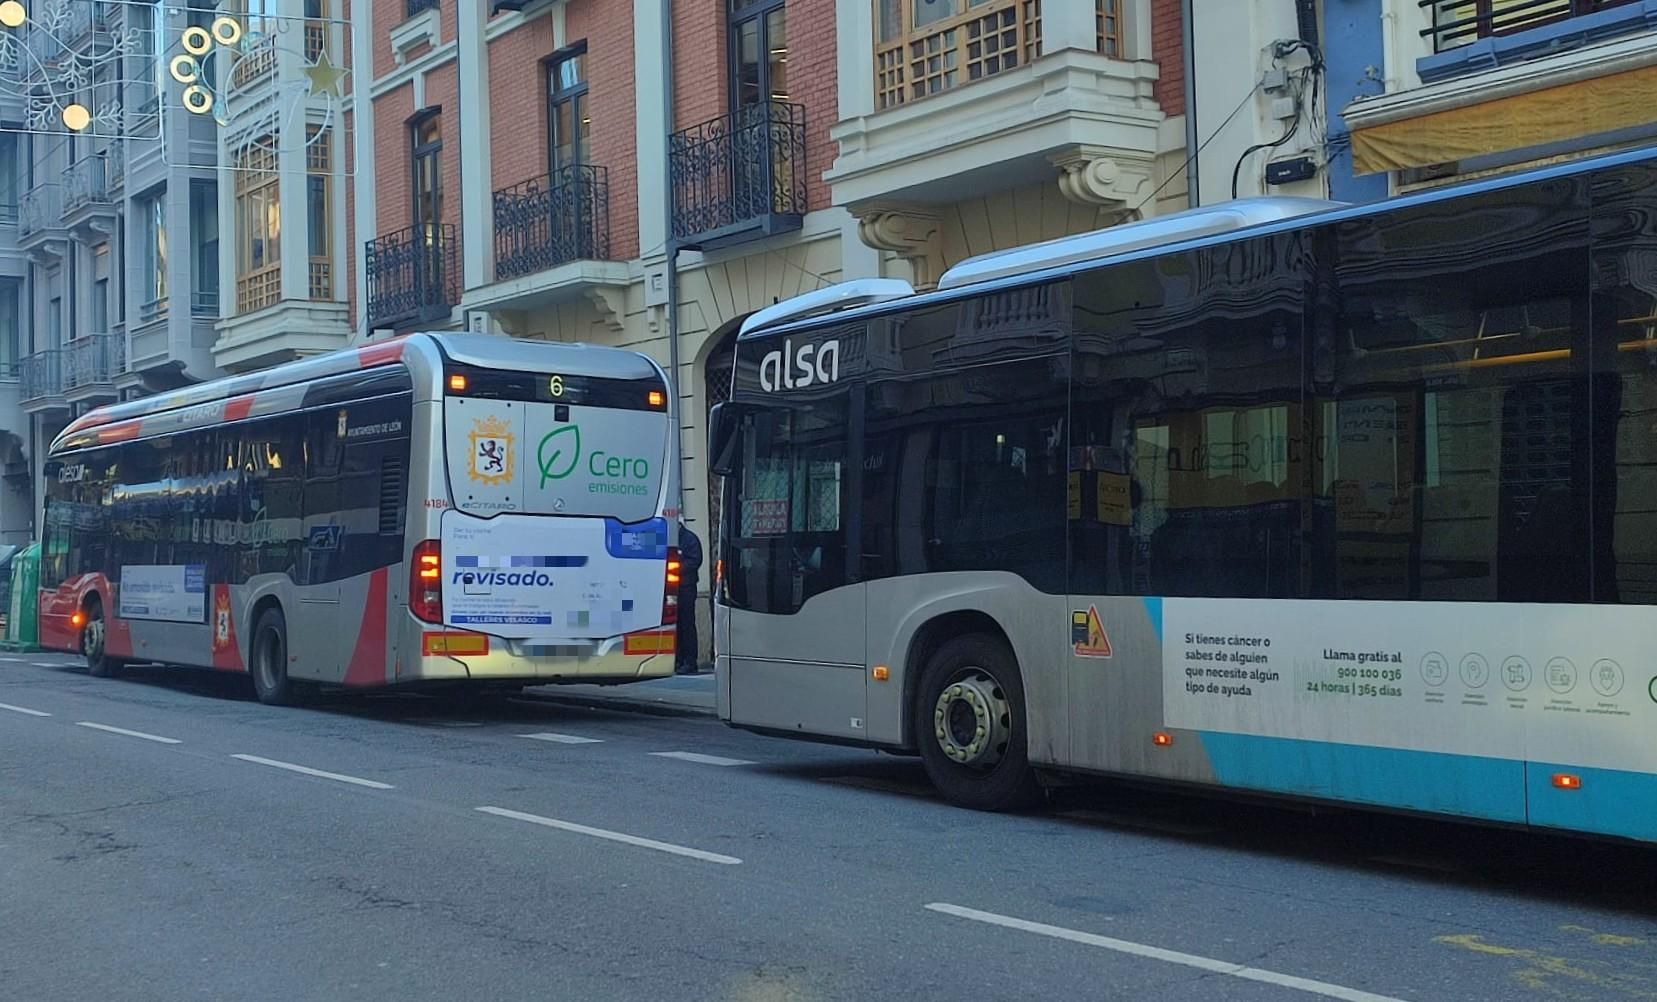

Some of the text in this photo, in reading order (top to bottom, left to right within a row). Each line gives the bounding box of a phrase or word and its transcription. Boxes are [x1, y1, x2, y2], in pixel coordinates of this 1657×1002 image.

[759, 338, 840, 393] alsa
[549, 375, 564, 397] 6
[589, 450, 649, 480] Cero
[588, 482, 648, 496] emisiones
[424, 499, 448, 509] 4184
[452, 569, 554, 587] revisado.
[466, 616, 538, 624] TALLERES VELASCO
[1185, 633, 1271, 647] Si tienes cáncer o
[1185, 649, 1268, 666] sabes de alguien
[1323, 648, 1402, 664] Llama gratis al
[1185, 667, 1204, 679] que
[1205, 668, 1248, 679] necesite
[1337, 667, 1402, 681] 900 100 036
[1185, 680, 1252, 698] tipo de ayuda
[1306, 682, 1319, 693] 24
[1320, 681, 1351, 694] horas
[1358, 684, 1377, 697] 365
